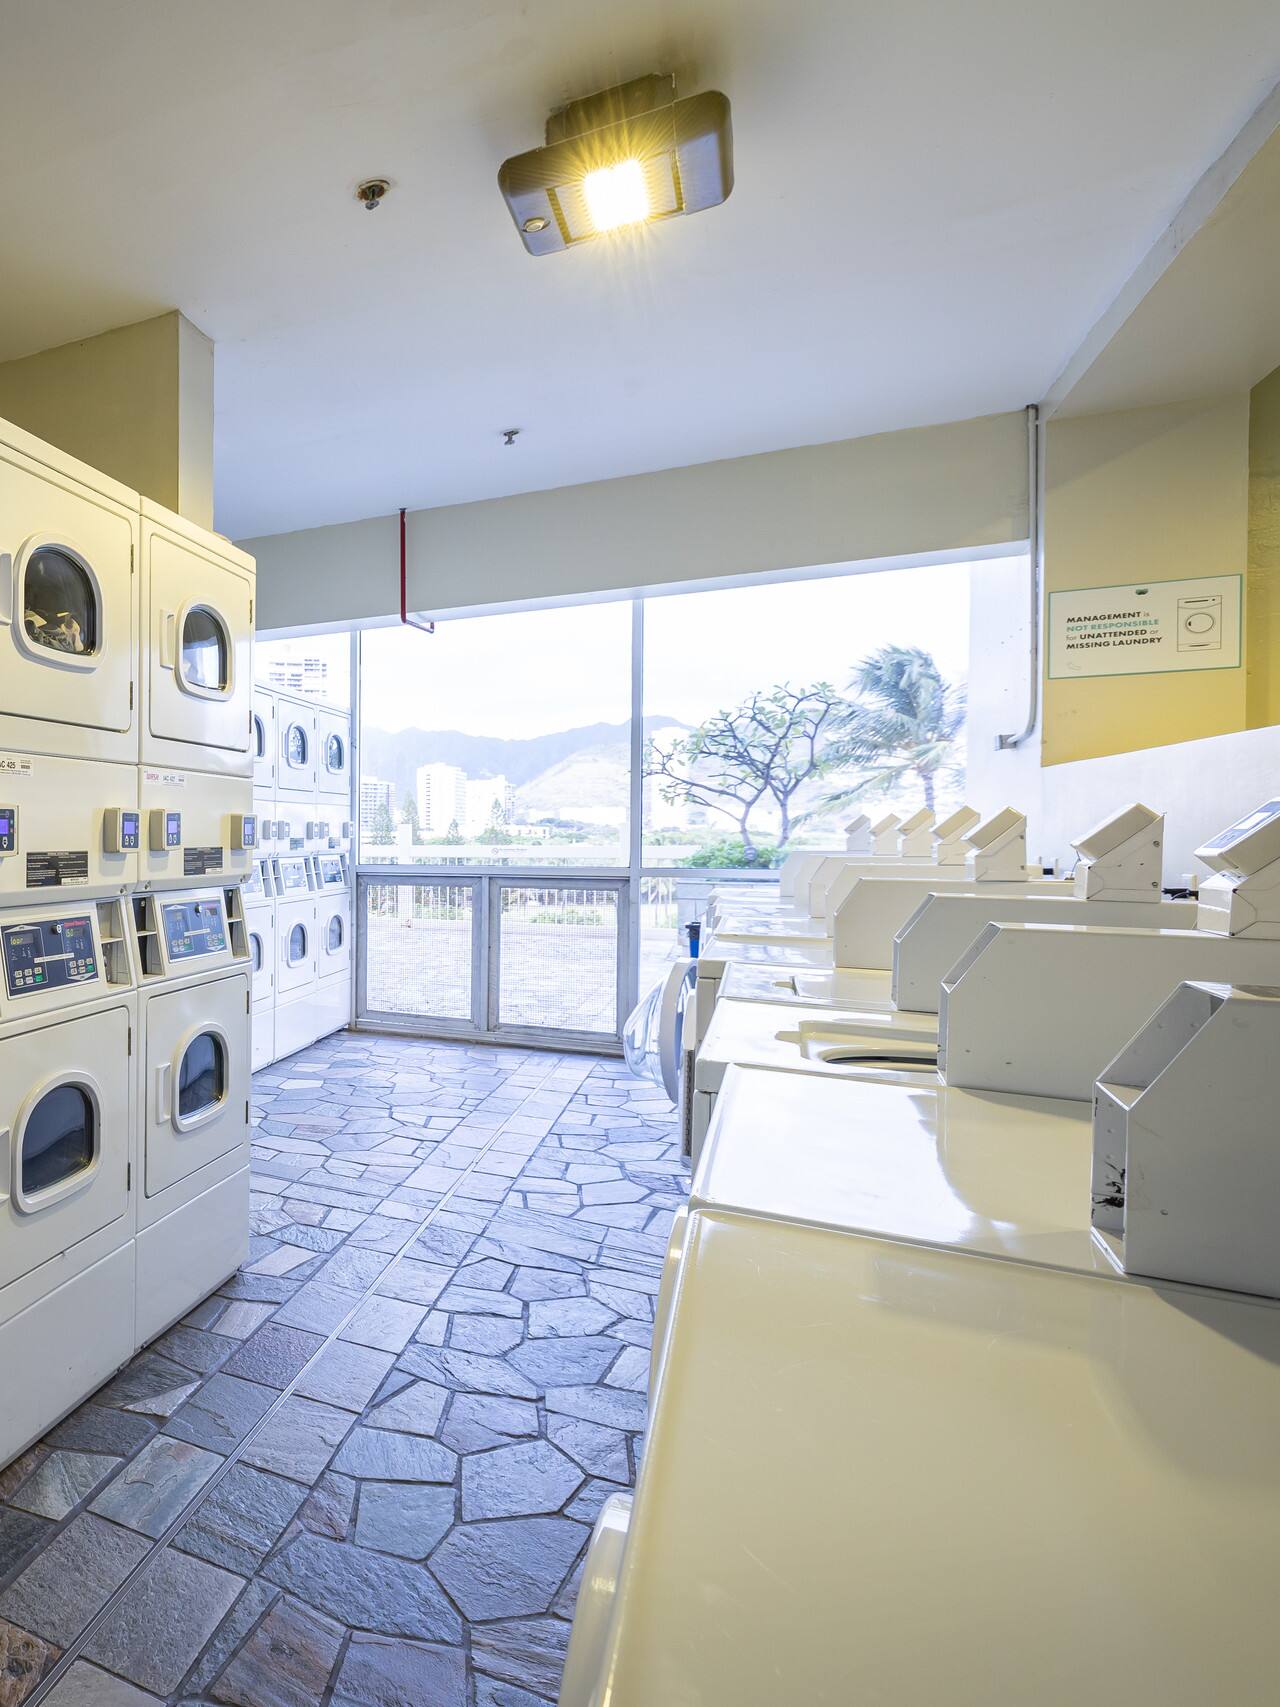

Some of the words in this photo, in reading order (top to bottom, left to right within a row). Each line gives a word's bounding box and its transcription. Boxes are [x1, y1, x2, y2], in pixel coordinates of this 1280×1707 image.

[1066, 611, 1141, 623] MANAGEMENT
[1090, 619, 1159, 630] RESPONSIBLE
[1079, 629, 1147, 640] UNATTENDED
[1066, 641, 1110, 650] MISSING
[1112, 637, 1162, 647] LAUNDRY
